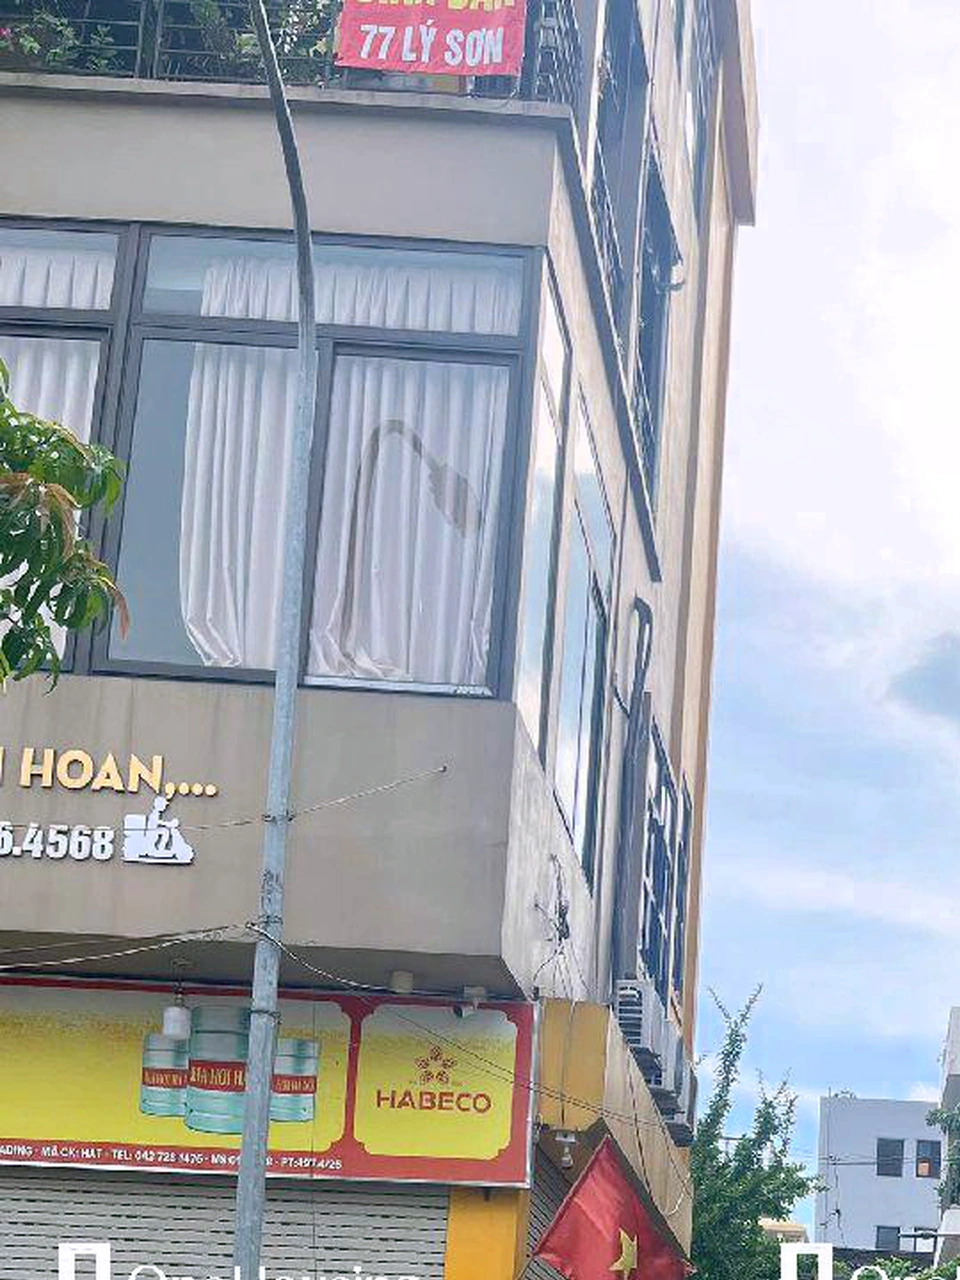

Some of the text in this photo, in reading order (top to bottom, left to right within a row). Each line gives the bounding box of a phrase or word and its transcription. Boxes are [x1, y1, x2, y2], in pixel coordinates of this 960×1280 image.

[360, 19, 504, 66] 77 LÝ SƠN
[376, 1089, 492, 1113] HABECO
